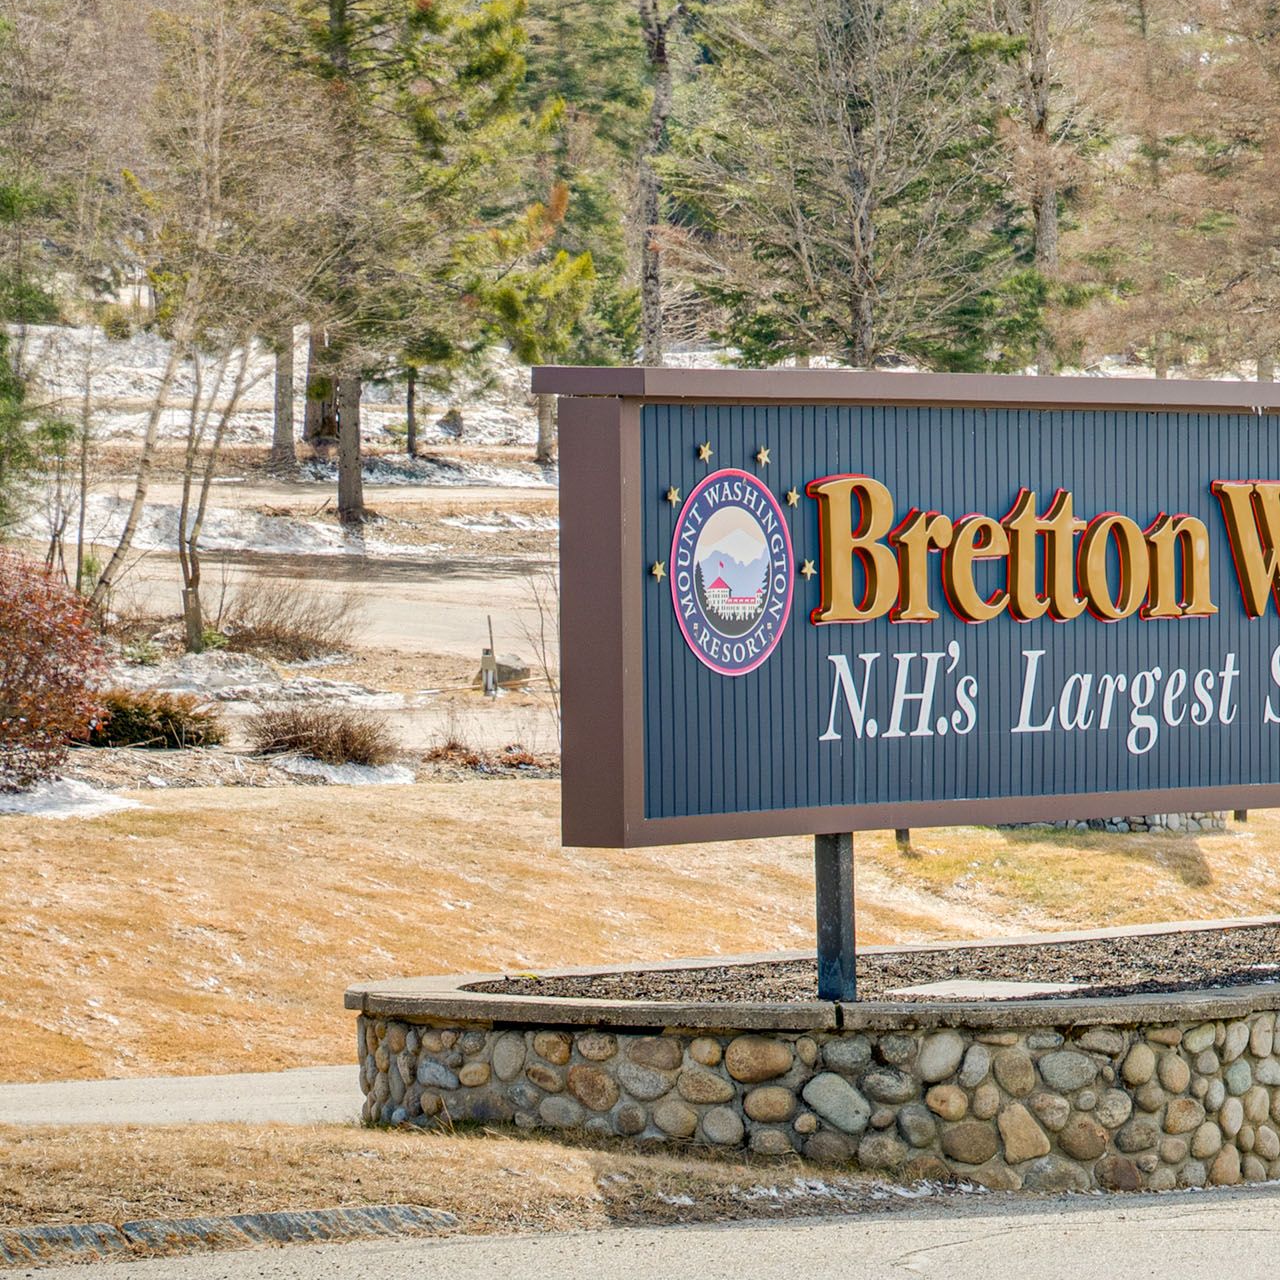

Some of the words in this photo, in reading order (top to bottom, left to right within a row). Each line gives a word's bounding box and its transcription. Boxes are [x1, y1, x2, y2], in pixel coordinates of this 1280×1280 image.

[678, 503, 705, 619] MOUNT
[704, 481, 787, 621] WASHINGTON
[806, 473, 1219, 625] Bretton
[698, 625, 767, 663] RESORT
[818, 640, 978, 741] N.H.'s
[1010, 649, 1239, 754] Largest
